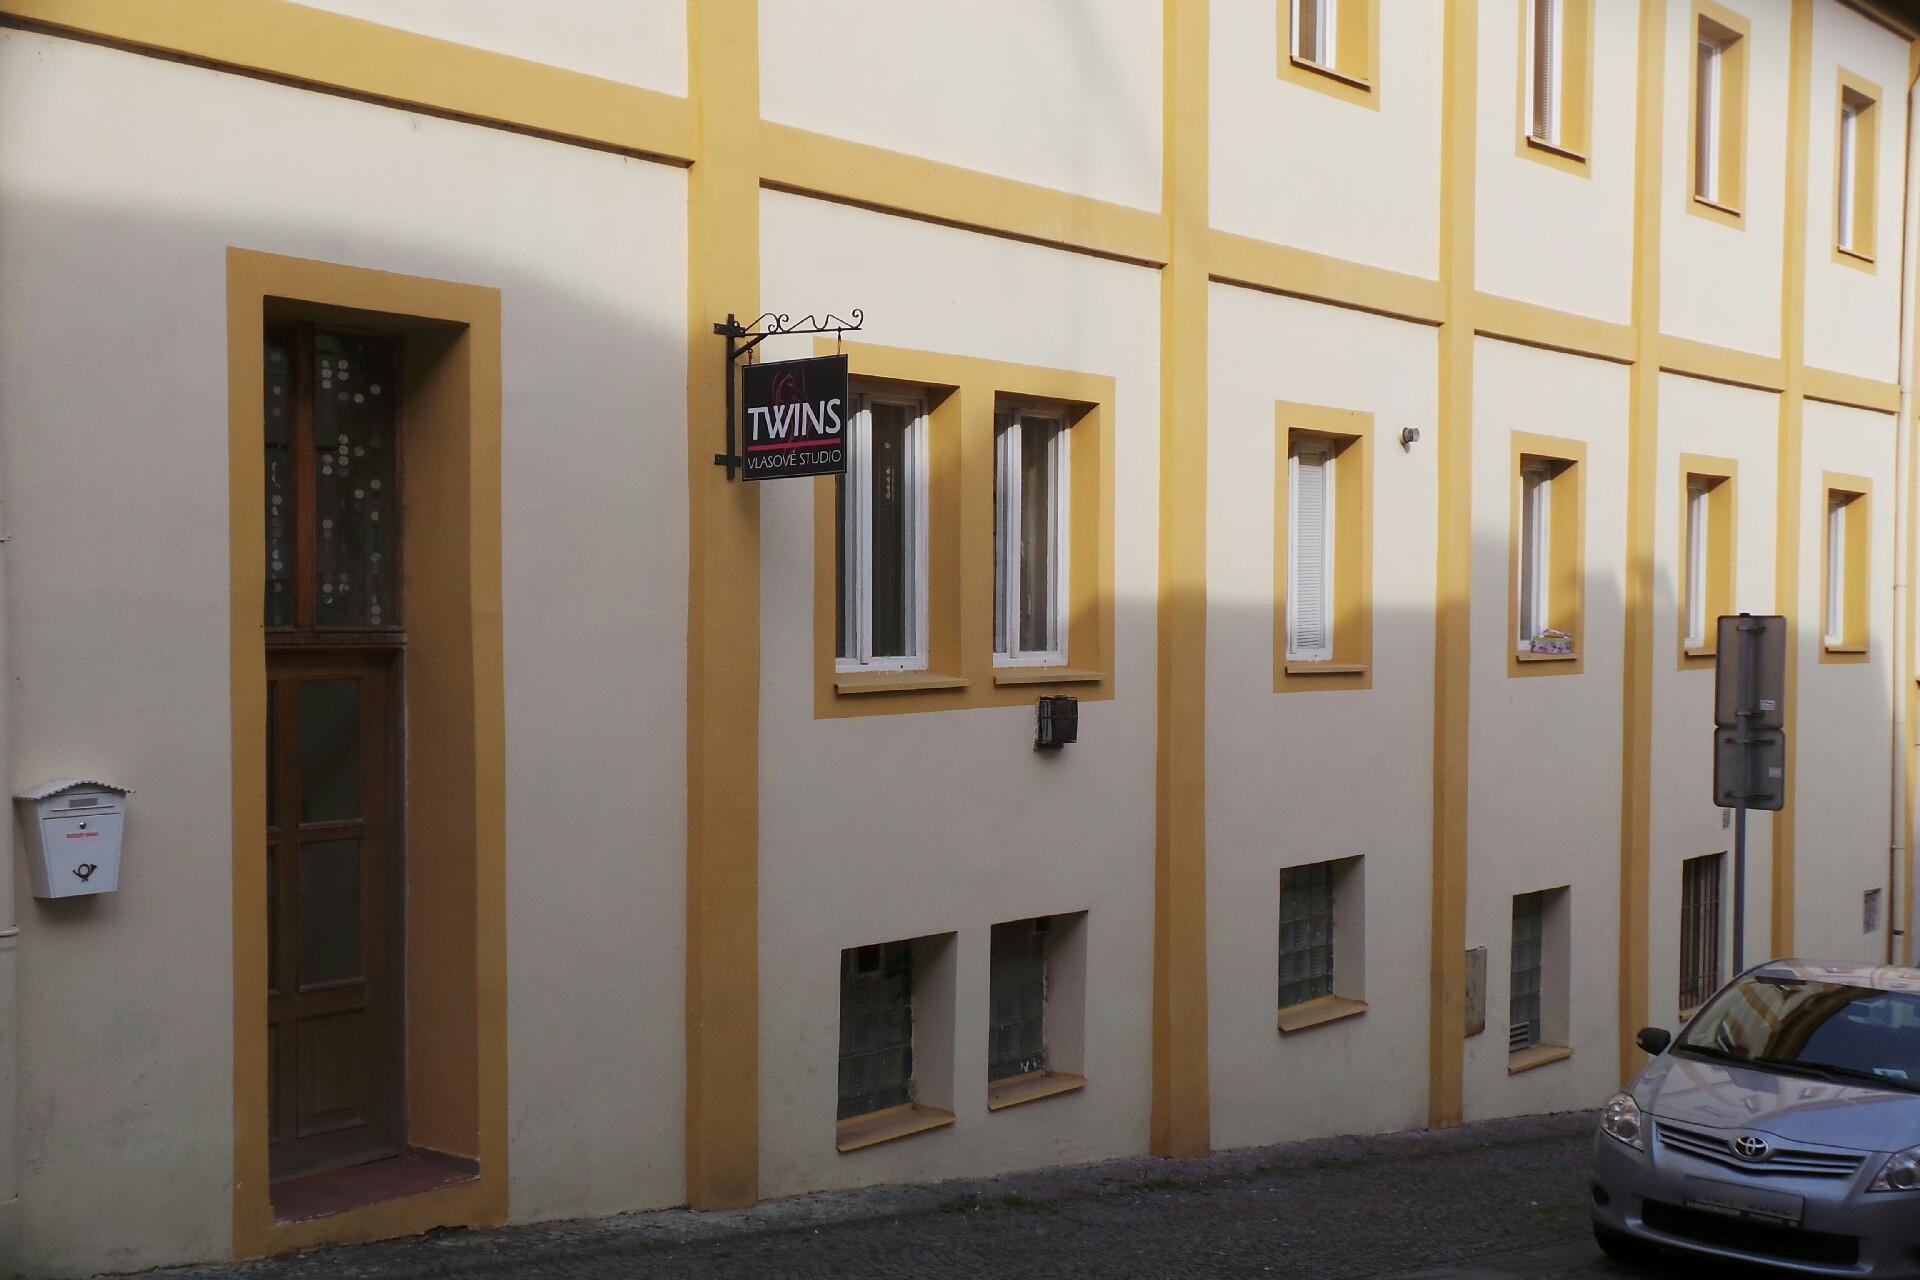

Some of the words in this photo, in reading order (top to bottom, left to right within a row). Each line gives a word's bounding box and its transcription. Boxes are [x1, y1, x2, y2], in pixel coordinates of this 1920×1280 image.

[747, 398, 841, 441] TWINS
[747, 449, 797, 469] VLASOVÉ
[799, 449, 842, 465] STUDIO
